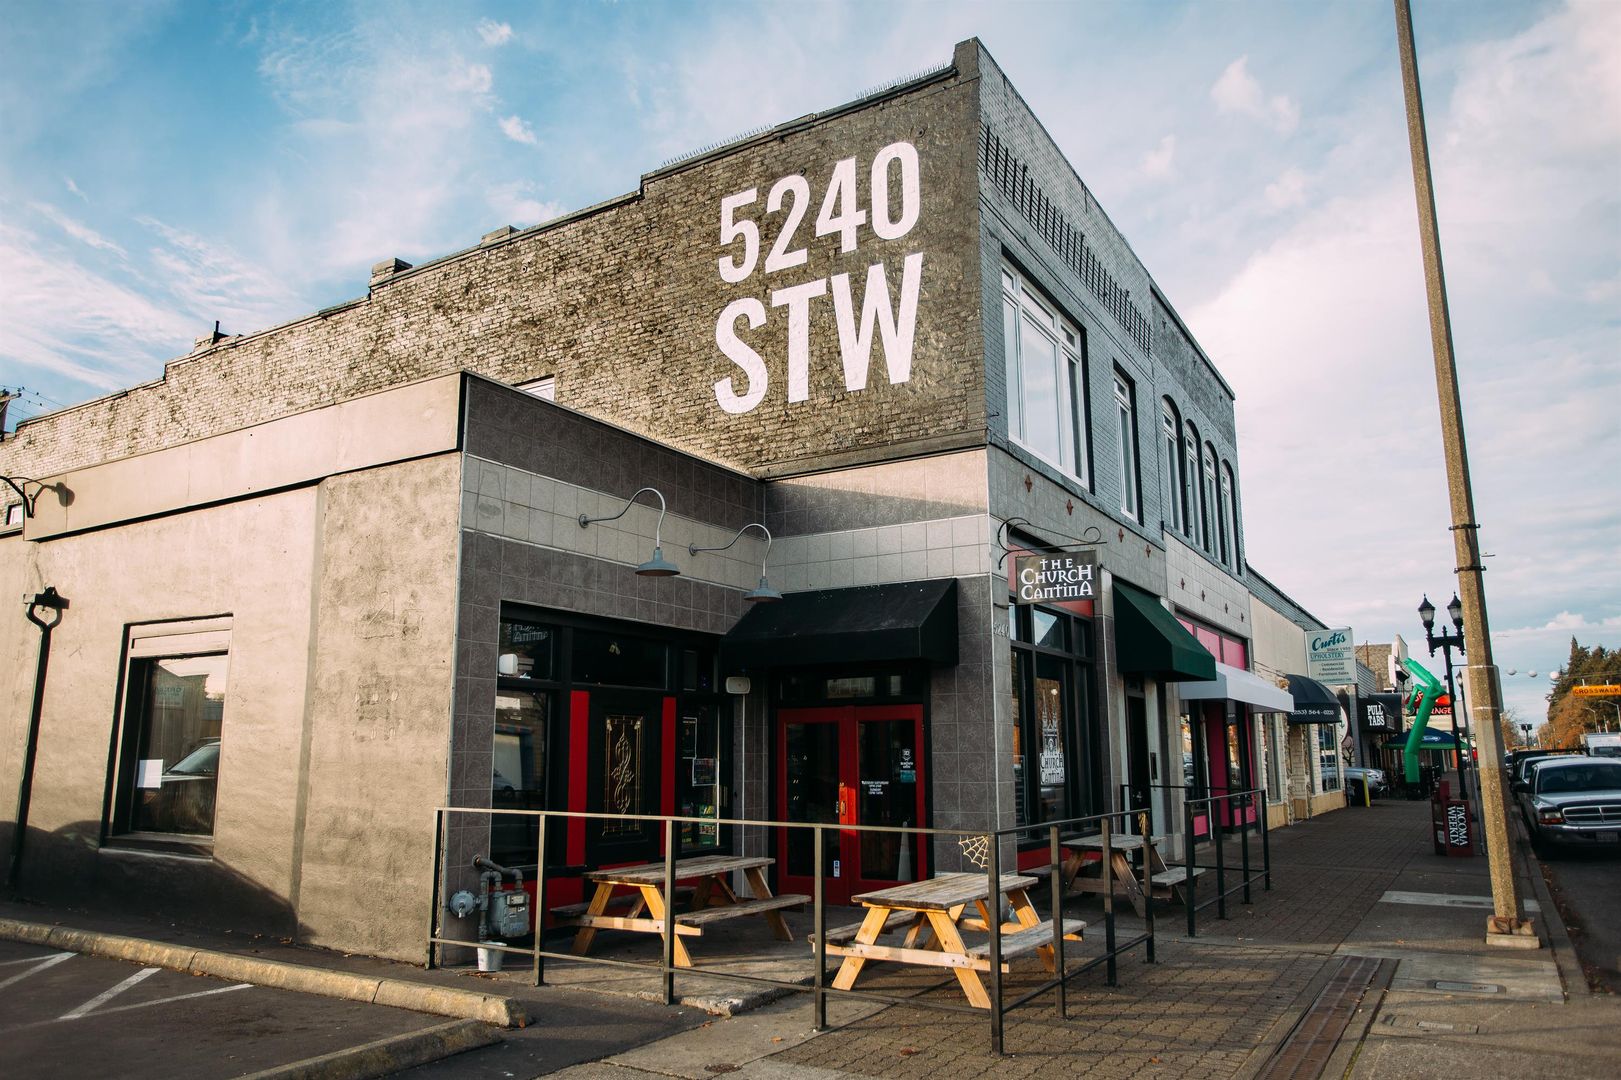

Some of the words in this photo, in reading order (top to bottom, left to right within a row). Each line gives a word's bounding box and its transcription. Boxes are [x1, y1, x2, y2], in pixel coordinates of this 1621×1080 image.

[718, 141, 921, 284] 5240
[713, 251, 924, 414] STW
[1040, 558, 1073, 571] THE
[1311, 631, 1347, 652] Curtis
[1574, 687, 1619, 695] CROSSWALK
[1366, 705, 1384, 716] PULL
[1368, 715, 1385, 727] TABS
[1447, 805, 1460, 846] WEEKLY
[1456, 804, 1469, 846] TACOMA
